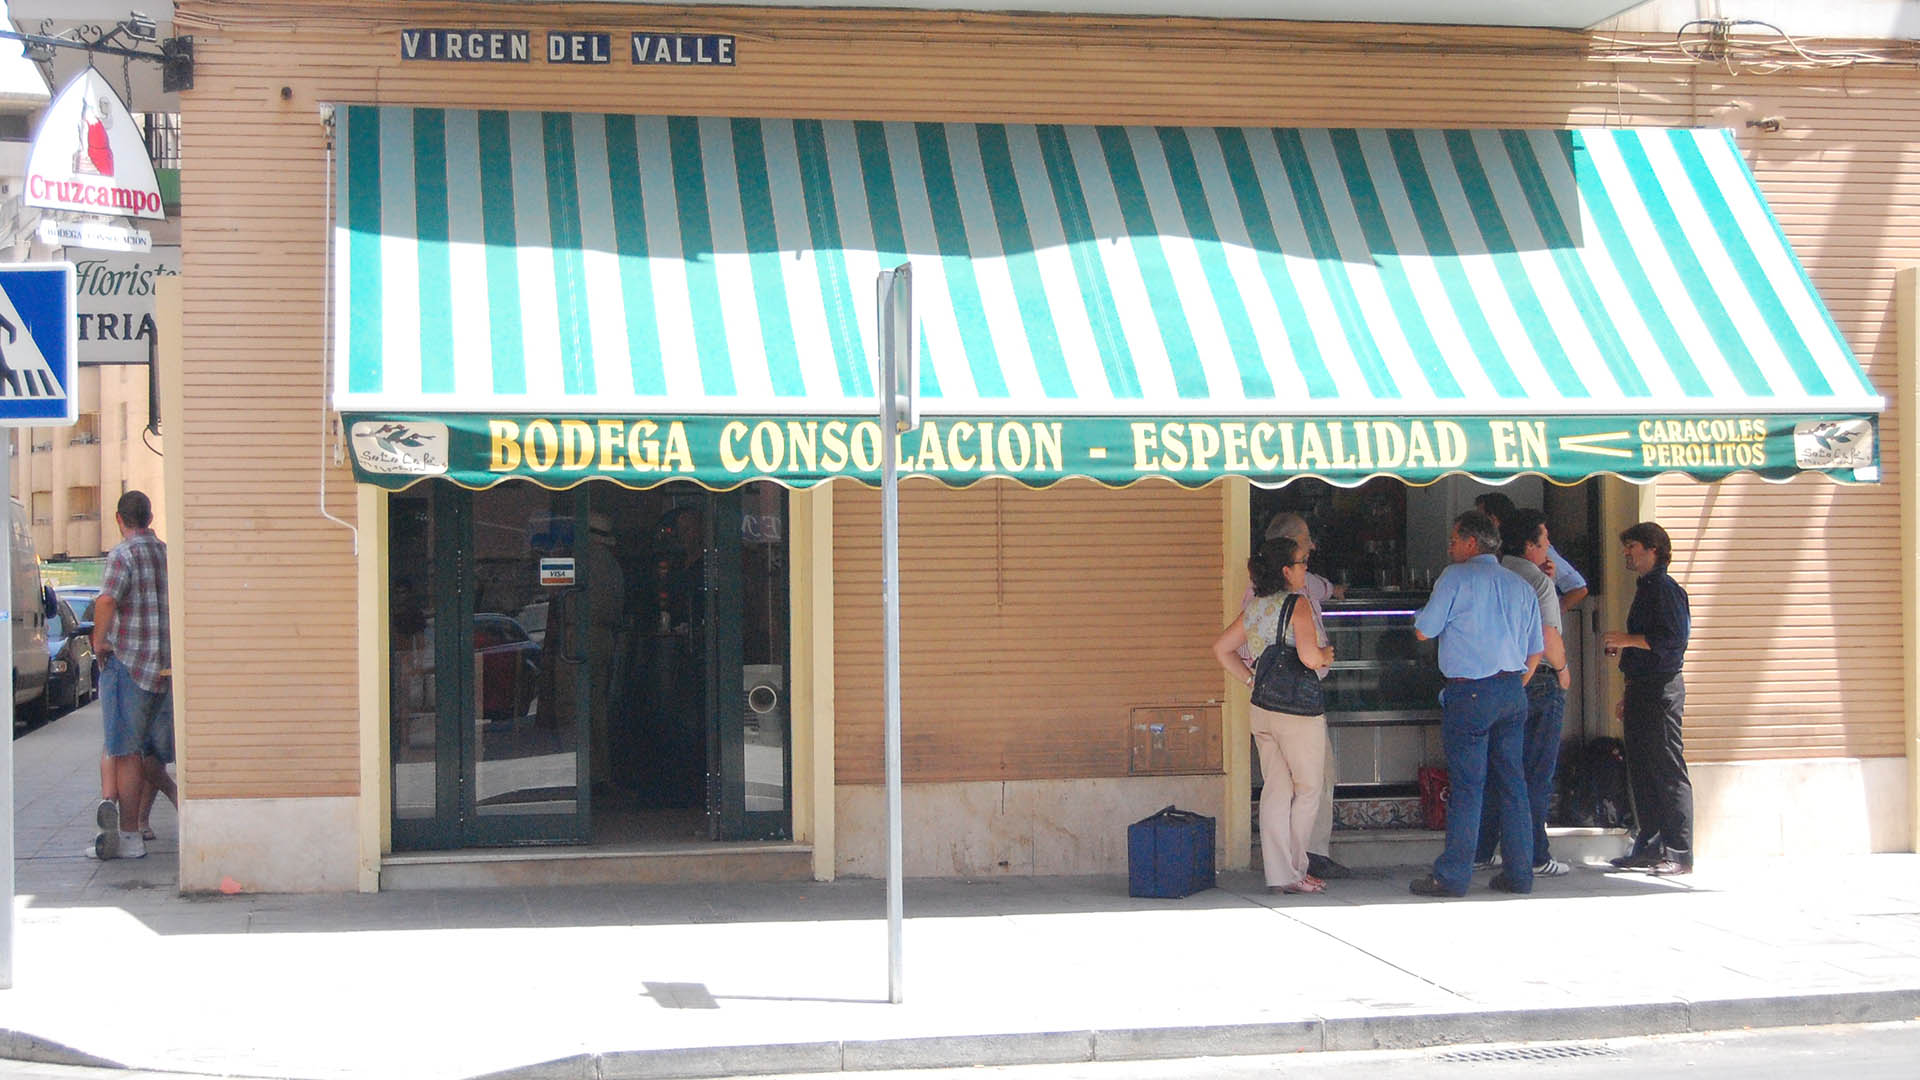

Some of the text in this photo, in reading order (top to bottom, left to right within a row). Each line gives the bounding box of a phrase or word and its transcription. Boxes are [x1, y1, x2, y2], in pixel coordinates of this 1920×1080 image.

[403, 32, 732, 63] VIRGEN DEL VALLE
[30, 174, 161, 215] Cruzcampo
[488, 418, 696, 473] BODEGA
[719, 420, 1063, 473] CONSOLACION
[1131, 420, 1468, 472] ESPECIALIDAD
[1489, 420, 1550, 469] EN
[1638, 418, 1767, 442] CARACOLES
[1641, 442, 1766, 467] PEROLITOS
